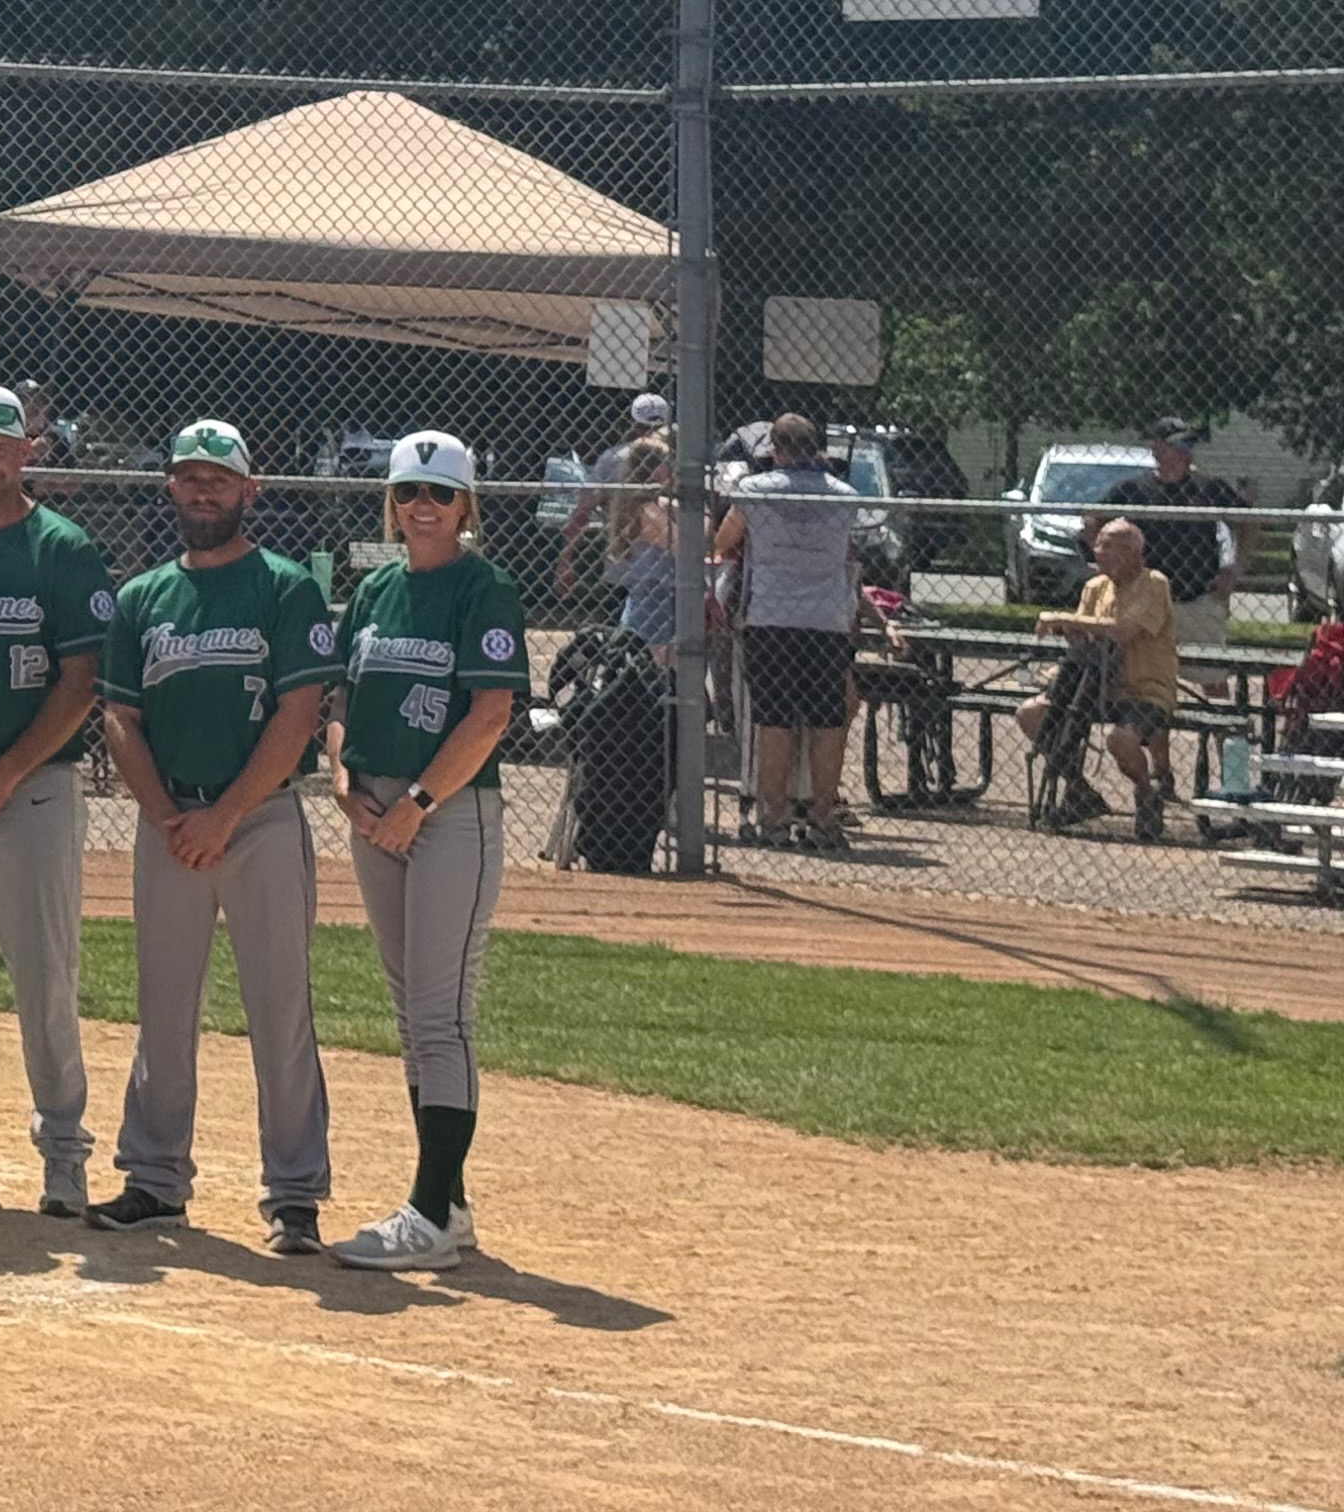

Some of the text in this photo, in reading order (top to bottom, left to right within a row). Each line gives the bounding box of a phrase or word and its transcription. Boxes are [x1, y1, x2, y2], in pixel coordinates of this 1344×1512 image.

[415, 442, 438, 465] V
[10, 644, 49, 690] 12
[243, 675, 267, 721] 7
[399, 683, 451, 734] 45
